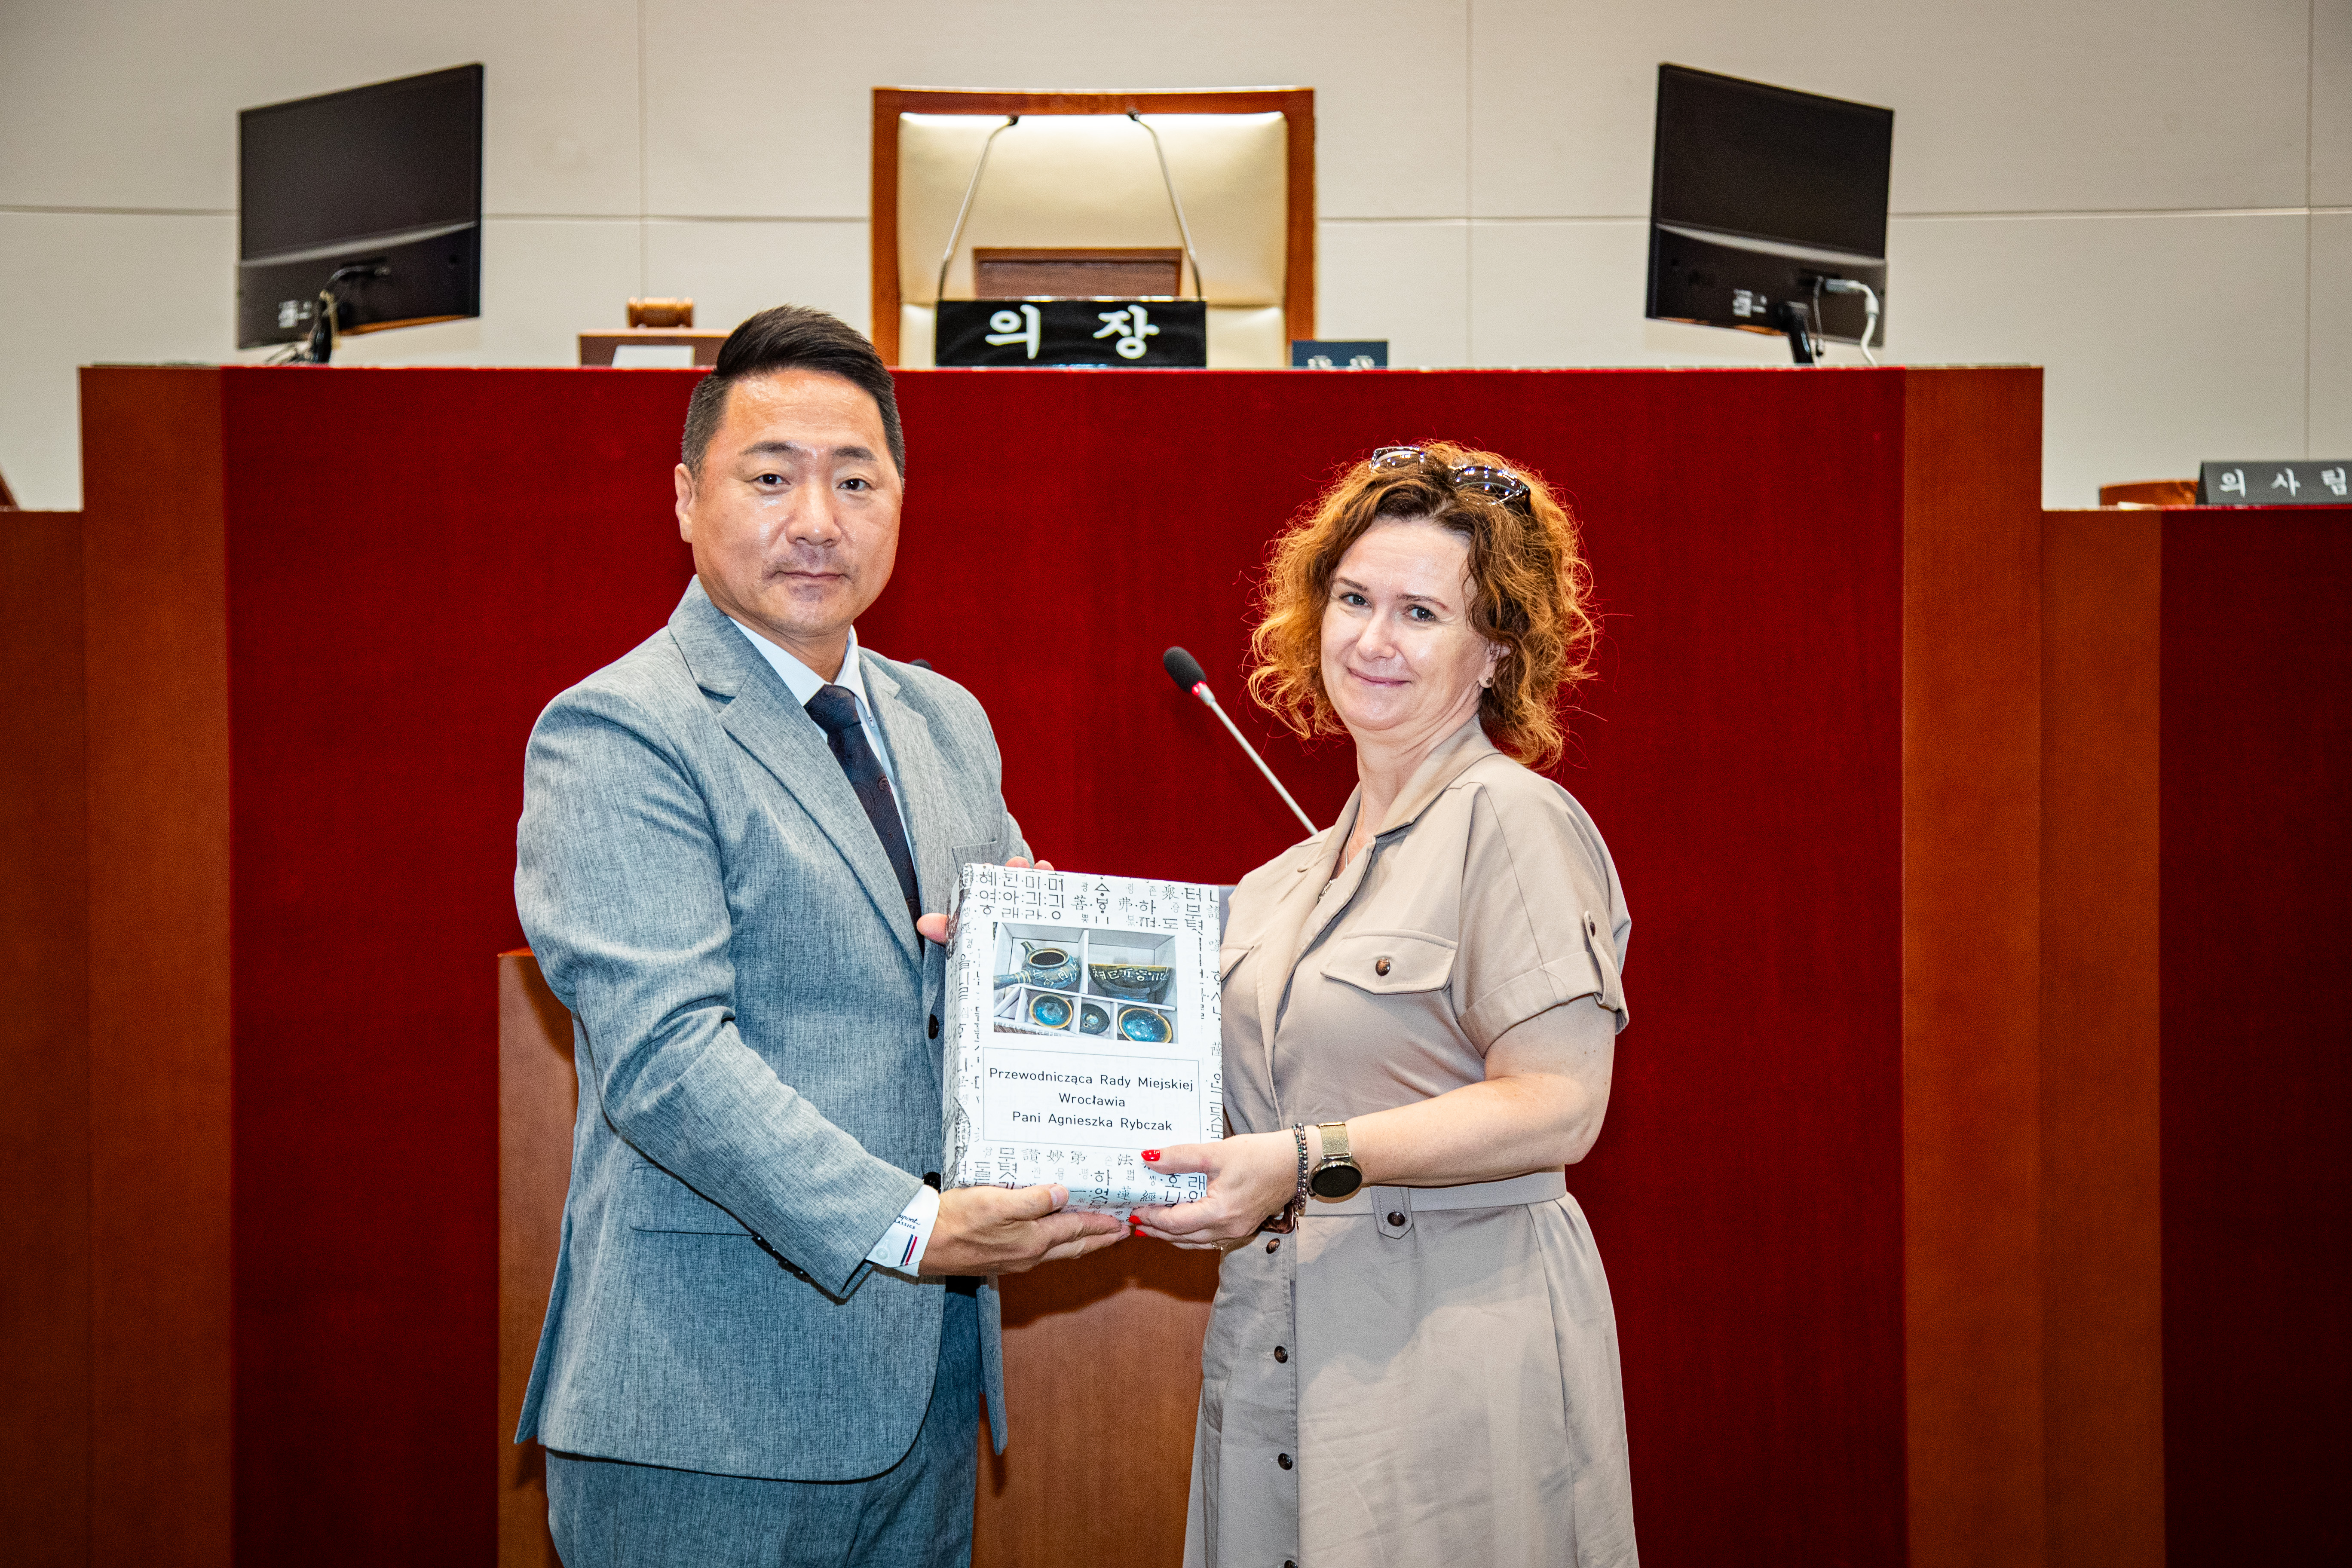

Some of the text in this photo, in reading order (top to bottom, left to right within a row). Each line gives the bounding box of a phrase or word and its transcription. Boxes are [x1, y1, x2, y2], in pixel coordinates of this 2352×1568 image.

[990, 1068, 1193, 1091] Przewodnicząca Rady Miejskiej
[1059, 1093, 1125, 1107] Wrocławia
[1013, 1112, 1172, 1131] Pani Agnieszka Rybczak
[899, 1215, 920, 1225] upont
